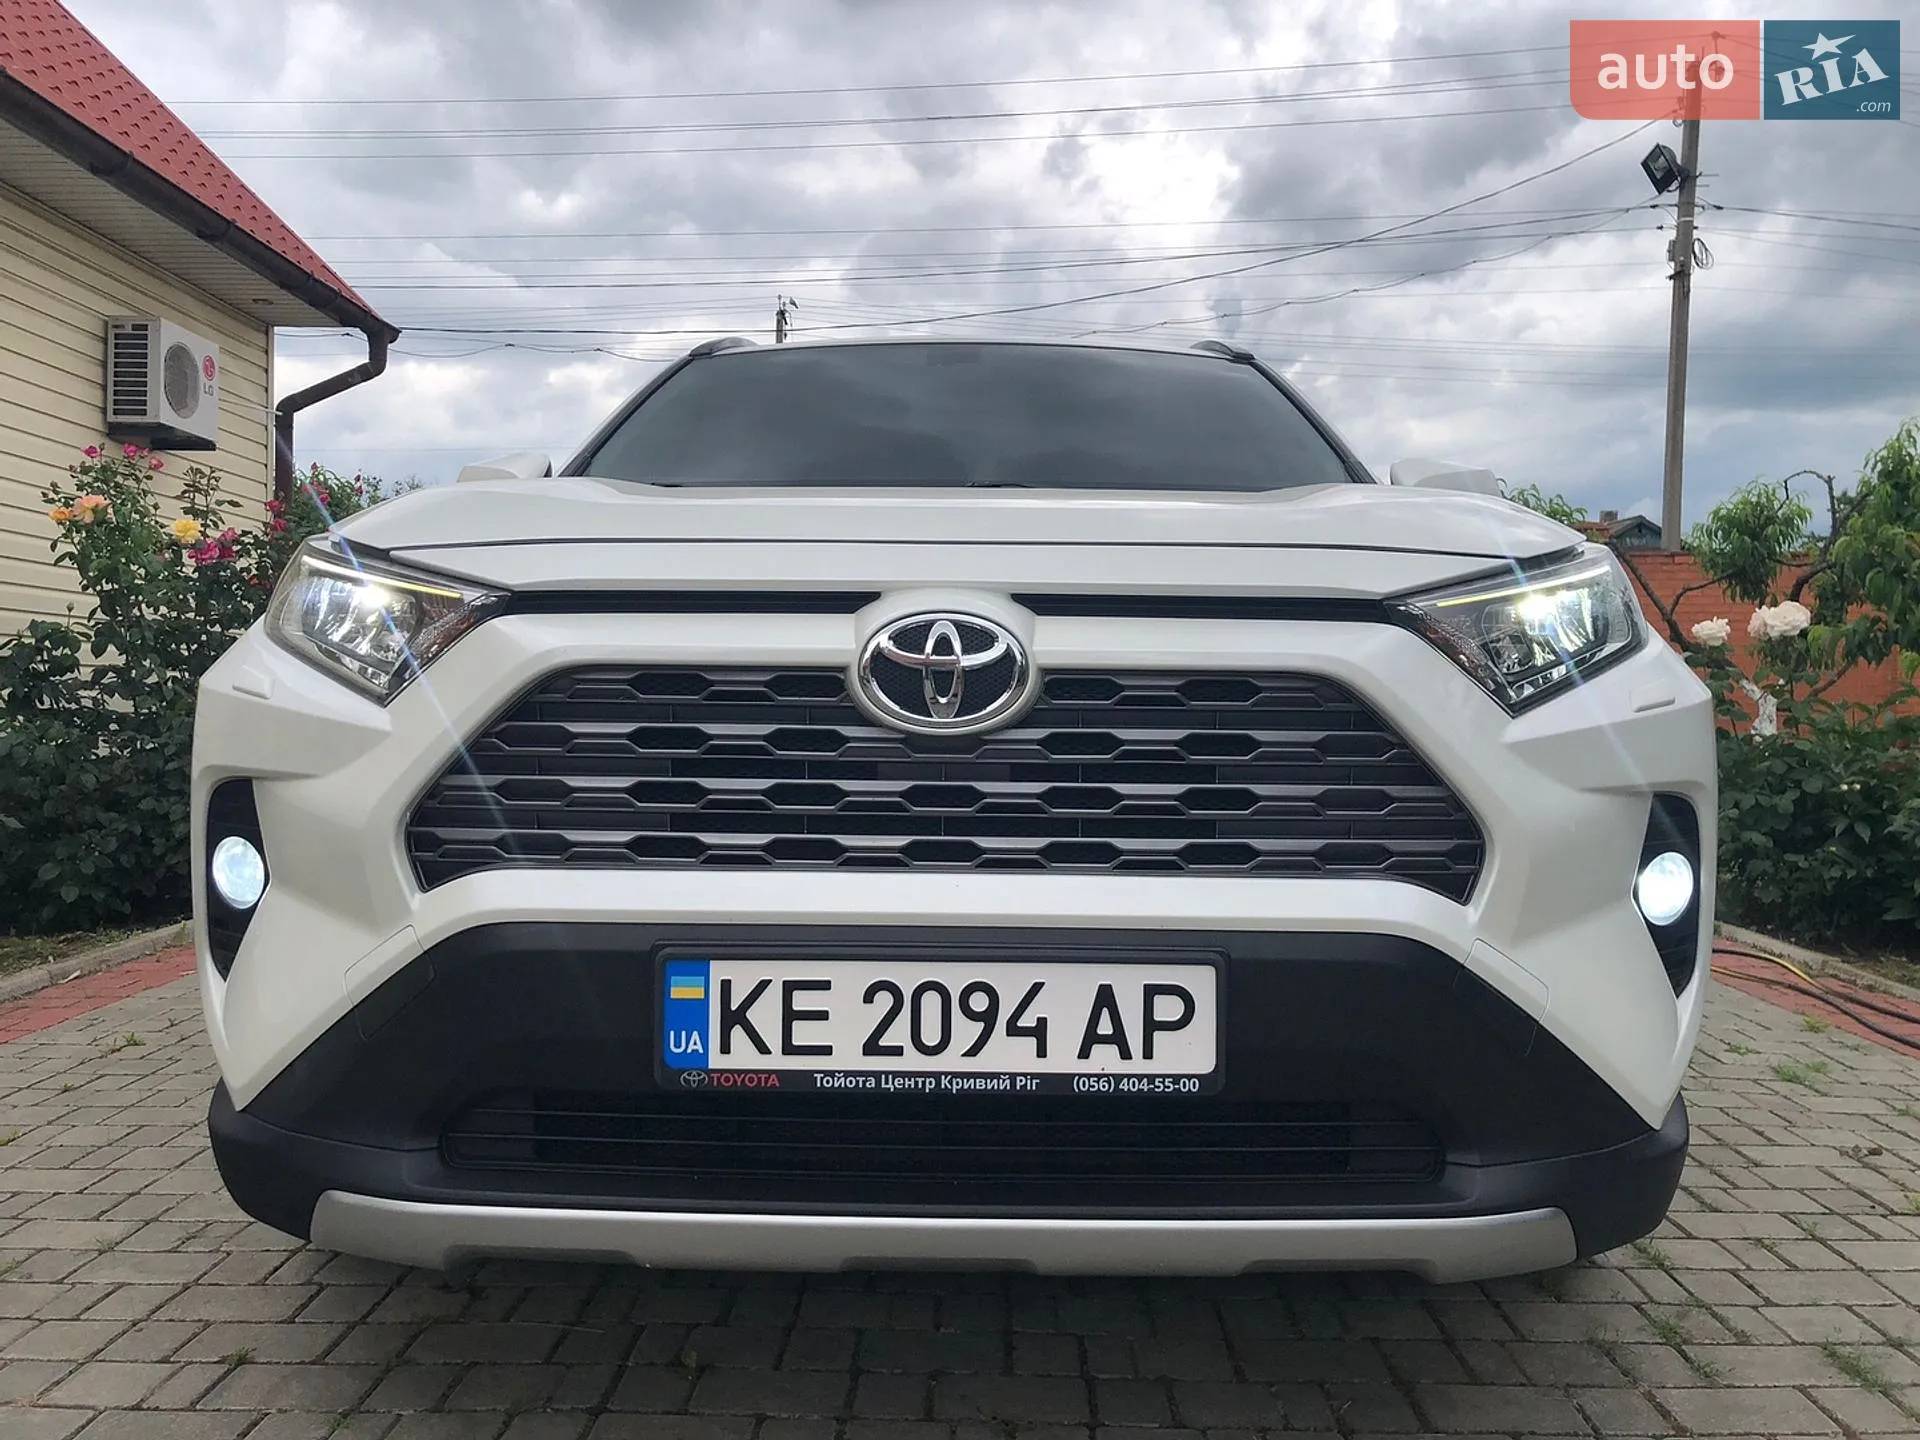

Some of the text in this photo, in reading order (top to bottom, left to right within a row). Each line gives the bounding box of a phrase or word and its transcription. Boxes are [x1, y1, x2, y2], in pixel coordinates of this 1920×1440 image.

[203, 382, 214, 396] LG
[718, 978, 1197, 1061] KE 2094 AP
[668, 1030, 704, 1055] UA
[710, 1073, 780, 1087] TOYOTA
[813, 1072, 1200, 1093] Тойота Центр Кривий Ріг (056) 404-55-00
